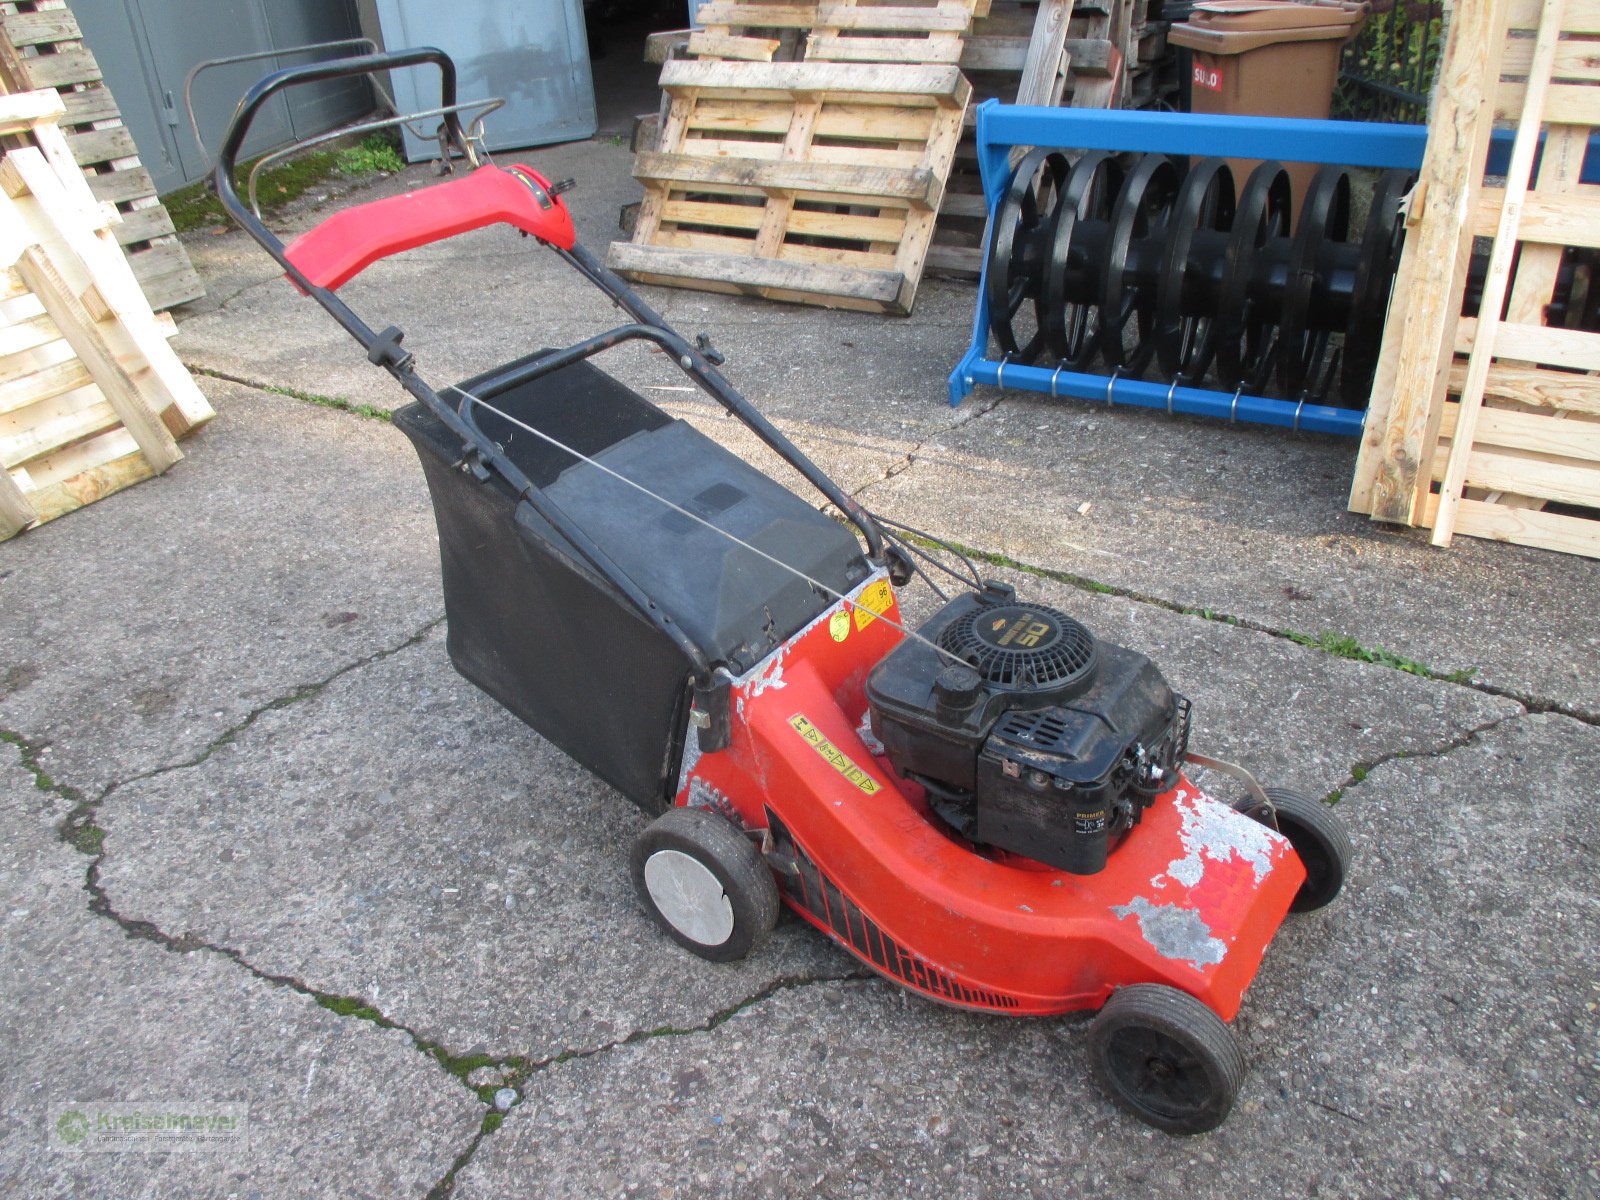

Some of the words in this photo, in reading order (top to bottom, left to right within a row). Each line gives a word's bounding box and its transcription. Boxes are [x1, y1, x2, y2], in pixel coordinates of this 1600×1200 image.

[1194, 67, 1217, 88] SULO
[1016, 622, 1050, 647] 50
[1076, 809, 1105, 819] PRIMER
